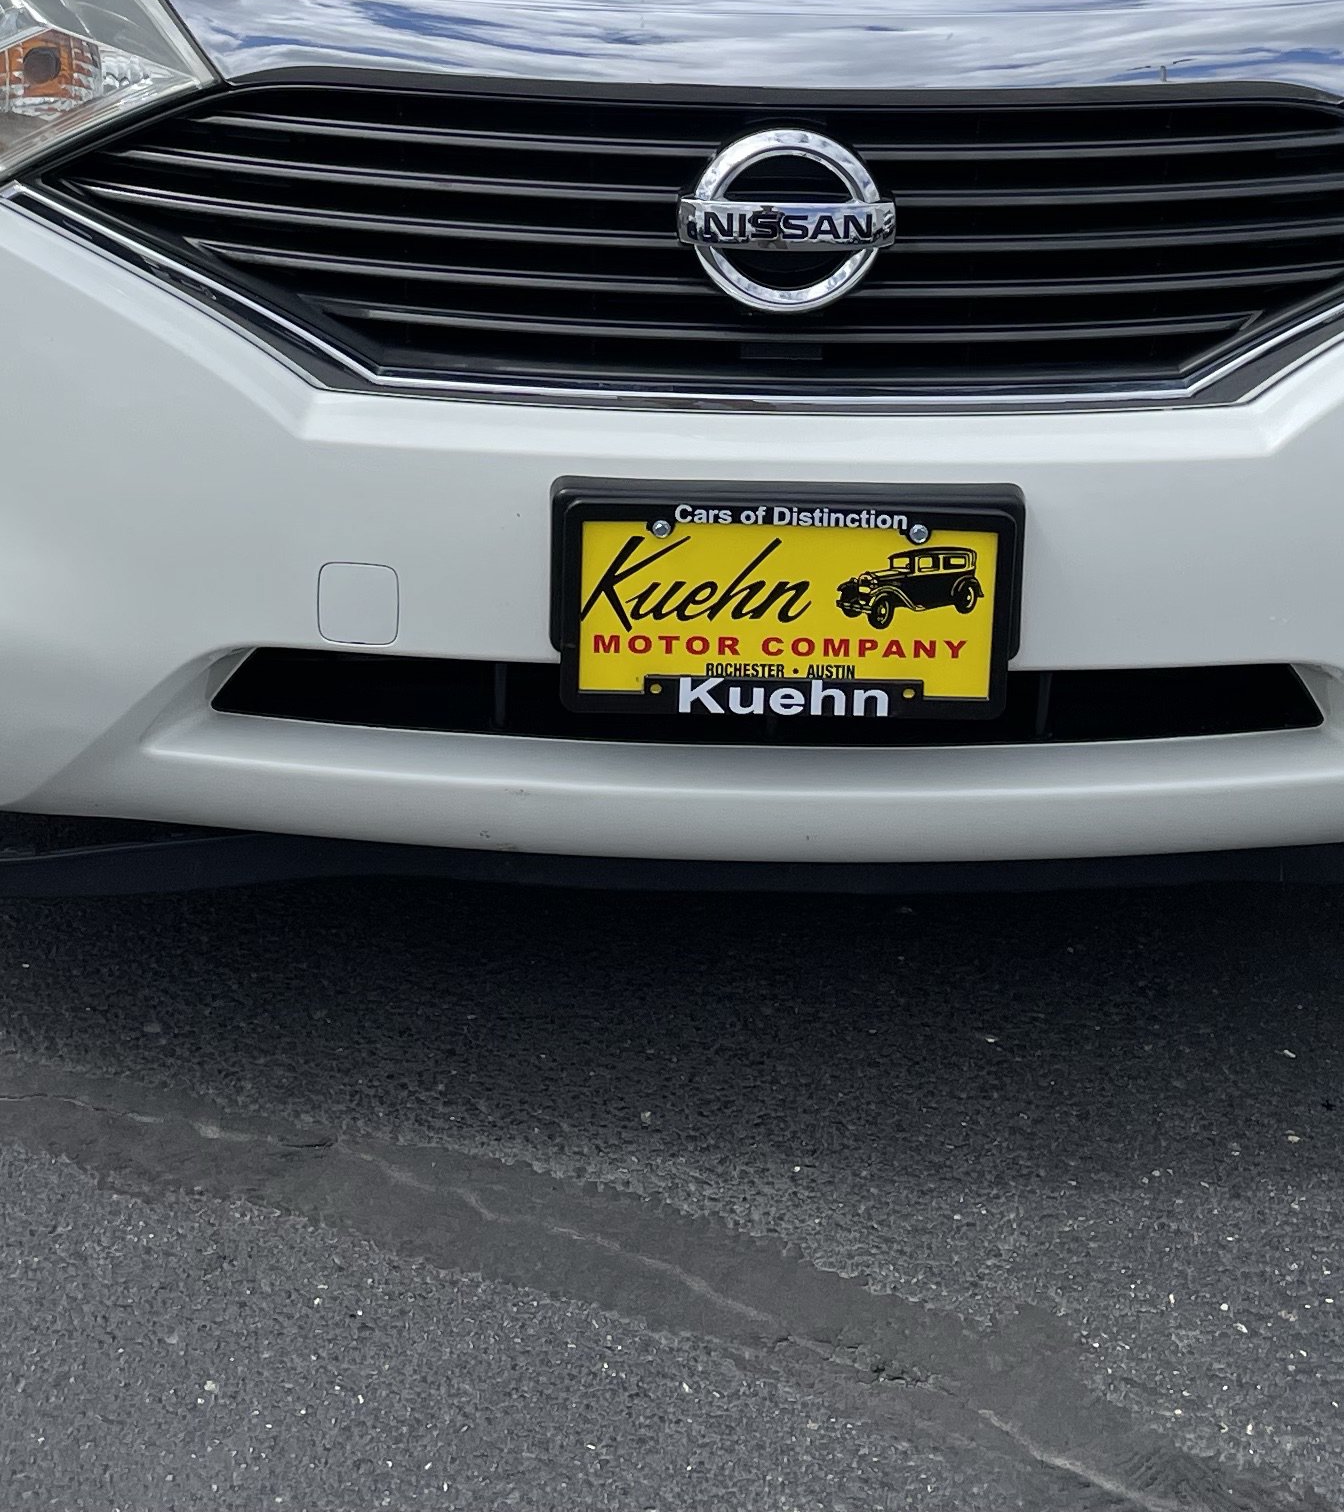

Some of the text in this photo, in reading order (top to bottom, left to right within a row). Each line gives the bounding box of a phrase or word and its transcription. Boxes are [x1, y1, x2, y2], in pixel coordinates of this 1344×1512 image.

[703, 211, 873, 241] NISSAN
[674, 504, 908, 531] Cars of Distinction
[581, 534, 814, 633] Kuehn
[592, 634, 968, 659] MOTOR COMPANY
[705, 662, 856, 680] ROCHESTER AUSTIN
[678, 676, 892, 718] Kuehn
